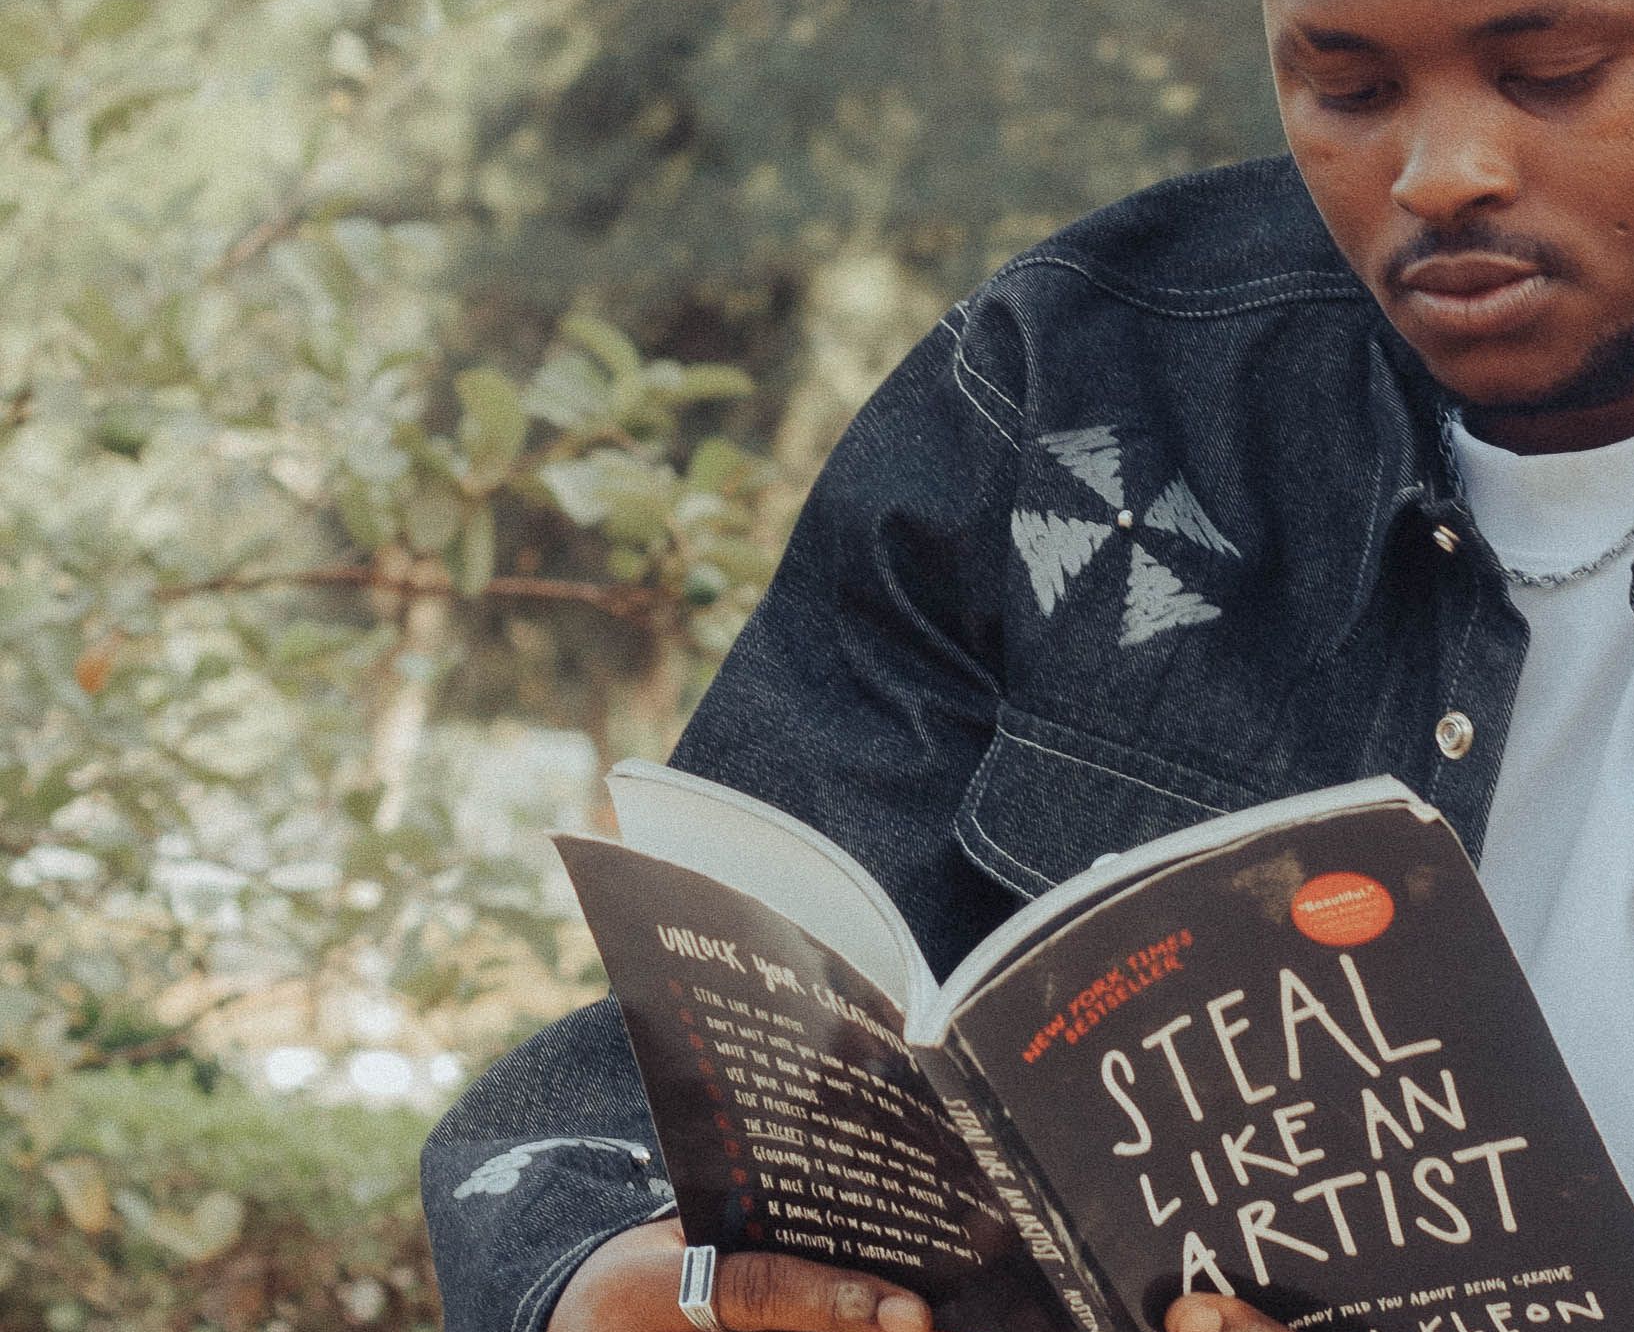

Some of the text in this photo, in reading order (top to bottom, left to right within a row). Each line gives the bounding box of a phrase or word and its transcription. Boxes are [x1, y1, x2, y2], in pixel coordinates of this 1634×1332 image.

[657, 924, 747, 974] UNLOCK
[693, 986, 726, 1009] STEAL
[727, 998, 751, 1017] LIKE
[1022, 928, 1194, 1064] NEW YORK TIMES
[1064, 955, 1184, 1046] BESTSELLER
[713, 1040, 746, 1059] WRITE
[1101, 953, 1442, 1156] STEAL
[725, 1067, 747, 1085] USE
[734, 1089, 758, 1108] SIDE
[762, 1096, 808, 1119] PROJECTS
[942, 1095, 993, 1144] STEAL
[744, 1118, 762, 1134] THE
[752, 1145, 811, 1174] GEOGRAPHY
[814, 1158, 825, 1171] IS
[842, 1165, 880, 1187] LONGER
[974, 1149, 1016, 1181] LIKE
[1139, 1069, 1467, 1226] LIKE AN
[760, 1172, 774, 1189] BE
[779, 1178, 804, 1195] NICE
[838, 1188, 873, 1208] WORLD
[890, 1201, 900, 1215] A
[767, 1200, 781, 1216] BE
[785, 1202, 823, 1225] BORING
[996, 1186, 1033, 1209] AN
[1010, 1211, 1066, 1264] ARTIST
[1182, 1136, 1528, 1298] ARTIST
[775, 1228, 836, 1255] CREATIVITY
[842, 1240, 852, 1253] IS
[1289, 1265, 1574, 1330] NOBODY TOLD YOU ABOUT BEING CREATIVE
